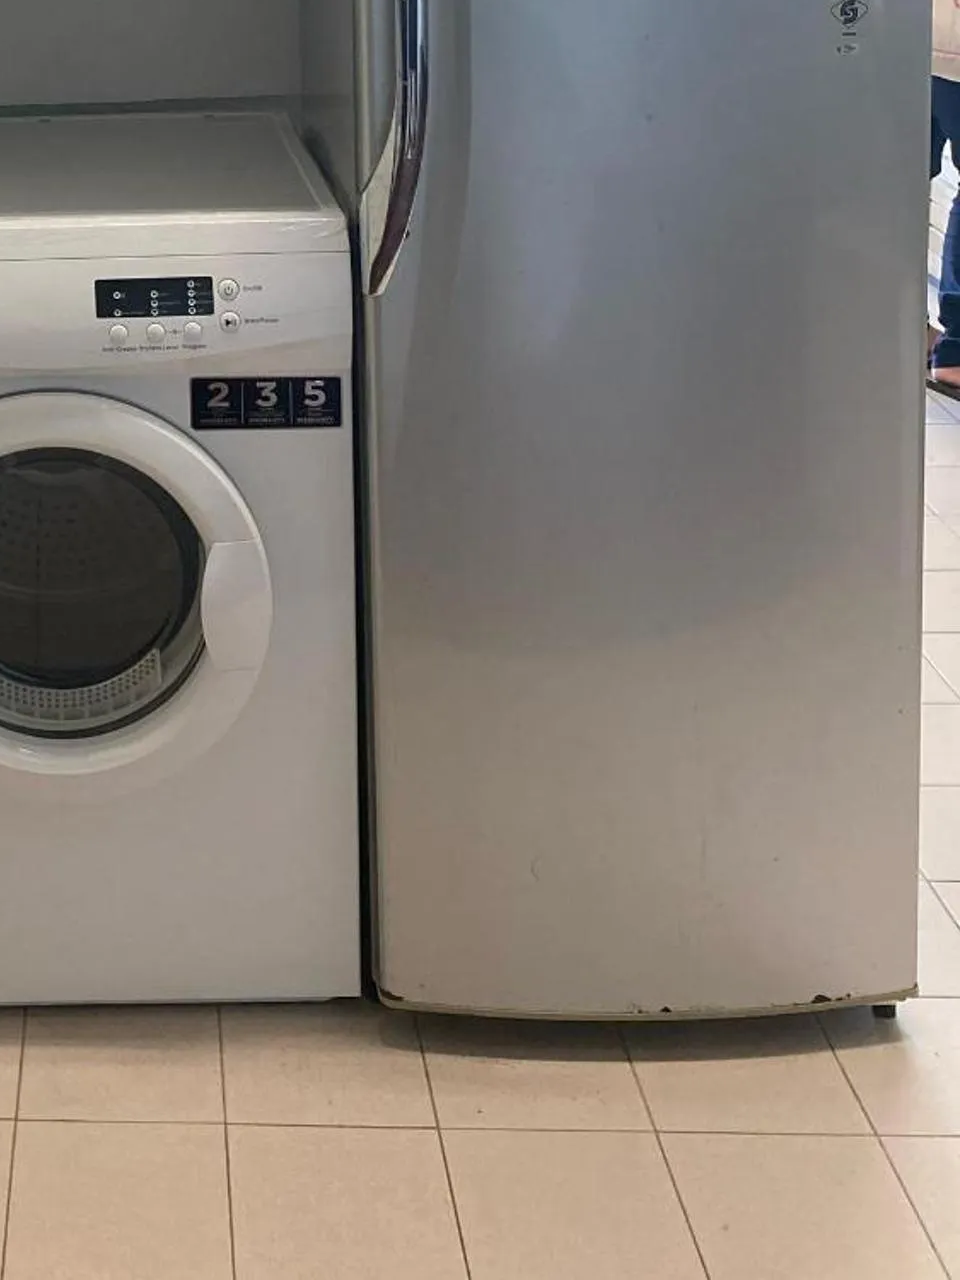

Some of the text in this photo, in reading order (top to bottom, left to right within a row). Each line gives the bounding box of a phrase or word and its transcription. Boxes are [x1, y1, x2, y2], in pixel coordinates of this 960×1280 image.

[207, 380, 326, 408] 2 3 5
